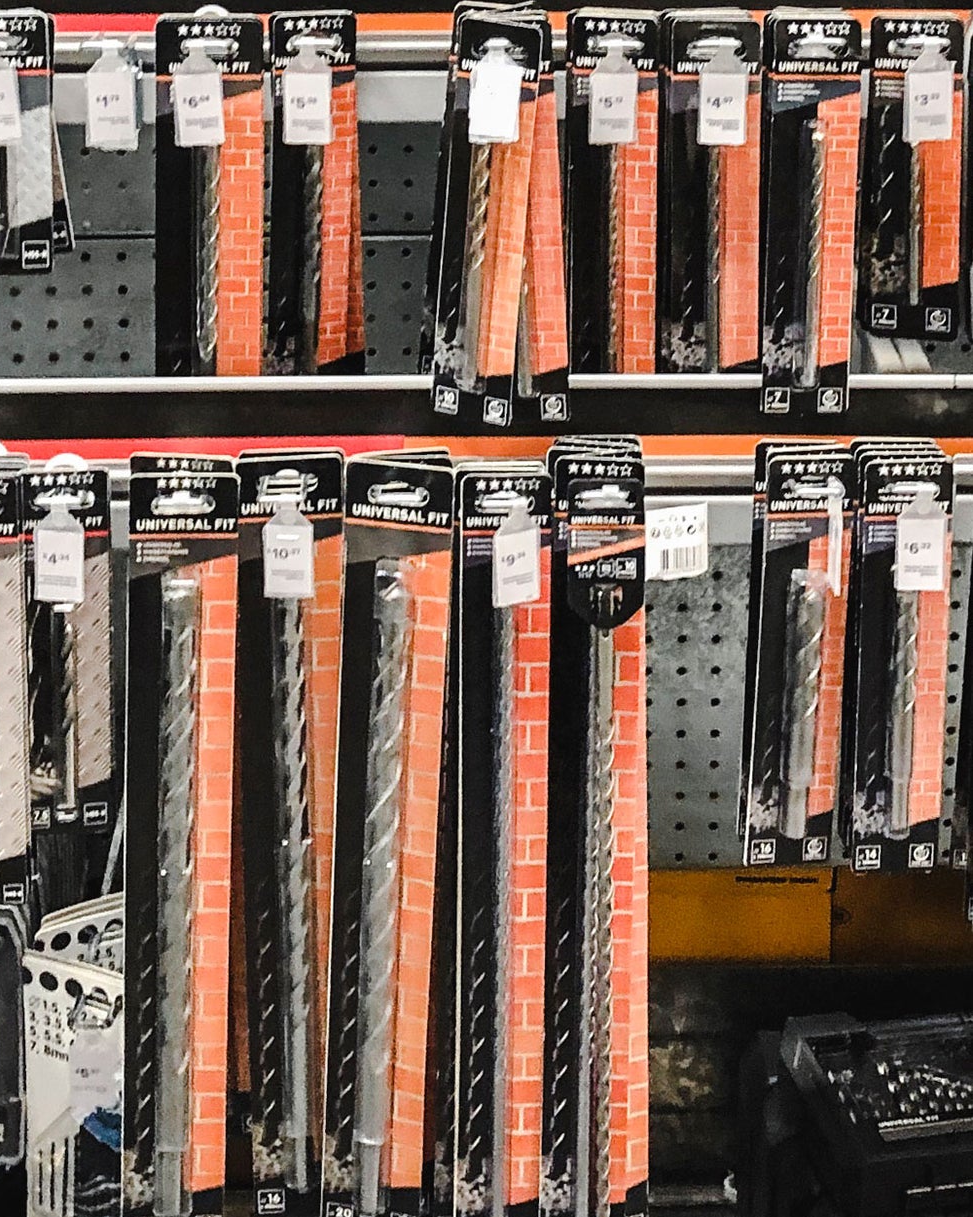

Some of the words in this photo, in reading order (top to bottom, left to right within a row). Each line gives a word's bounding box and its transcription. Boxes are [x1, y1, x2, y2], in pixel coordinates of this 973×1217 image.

[26, 55, 44, 68] FIT
[232, 61, 250, 73] FIT
[637, 58, 654, 71] FIT
[778, 60, 839, 74] UNIVERSAL
[841, 60, 858, 73] FIT
[241, 499, 314, 517] UNIVAL
[317, 498, 338, 511] FIT
[770, 499, 828, 513] UNIVERSA
[352, 502, 425, 525] UNIVERSAL
[427, 511, 449, 526] FIT
[571, 515, 621, 526] UNIVERSAL
[622, 515, 635, 526] FIT
[85, 516, 103, 527] FIT
[135, 517, 212, 532] UNIVERSAL
[214, 517, 236, 531] FIT
